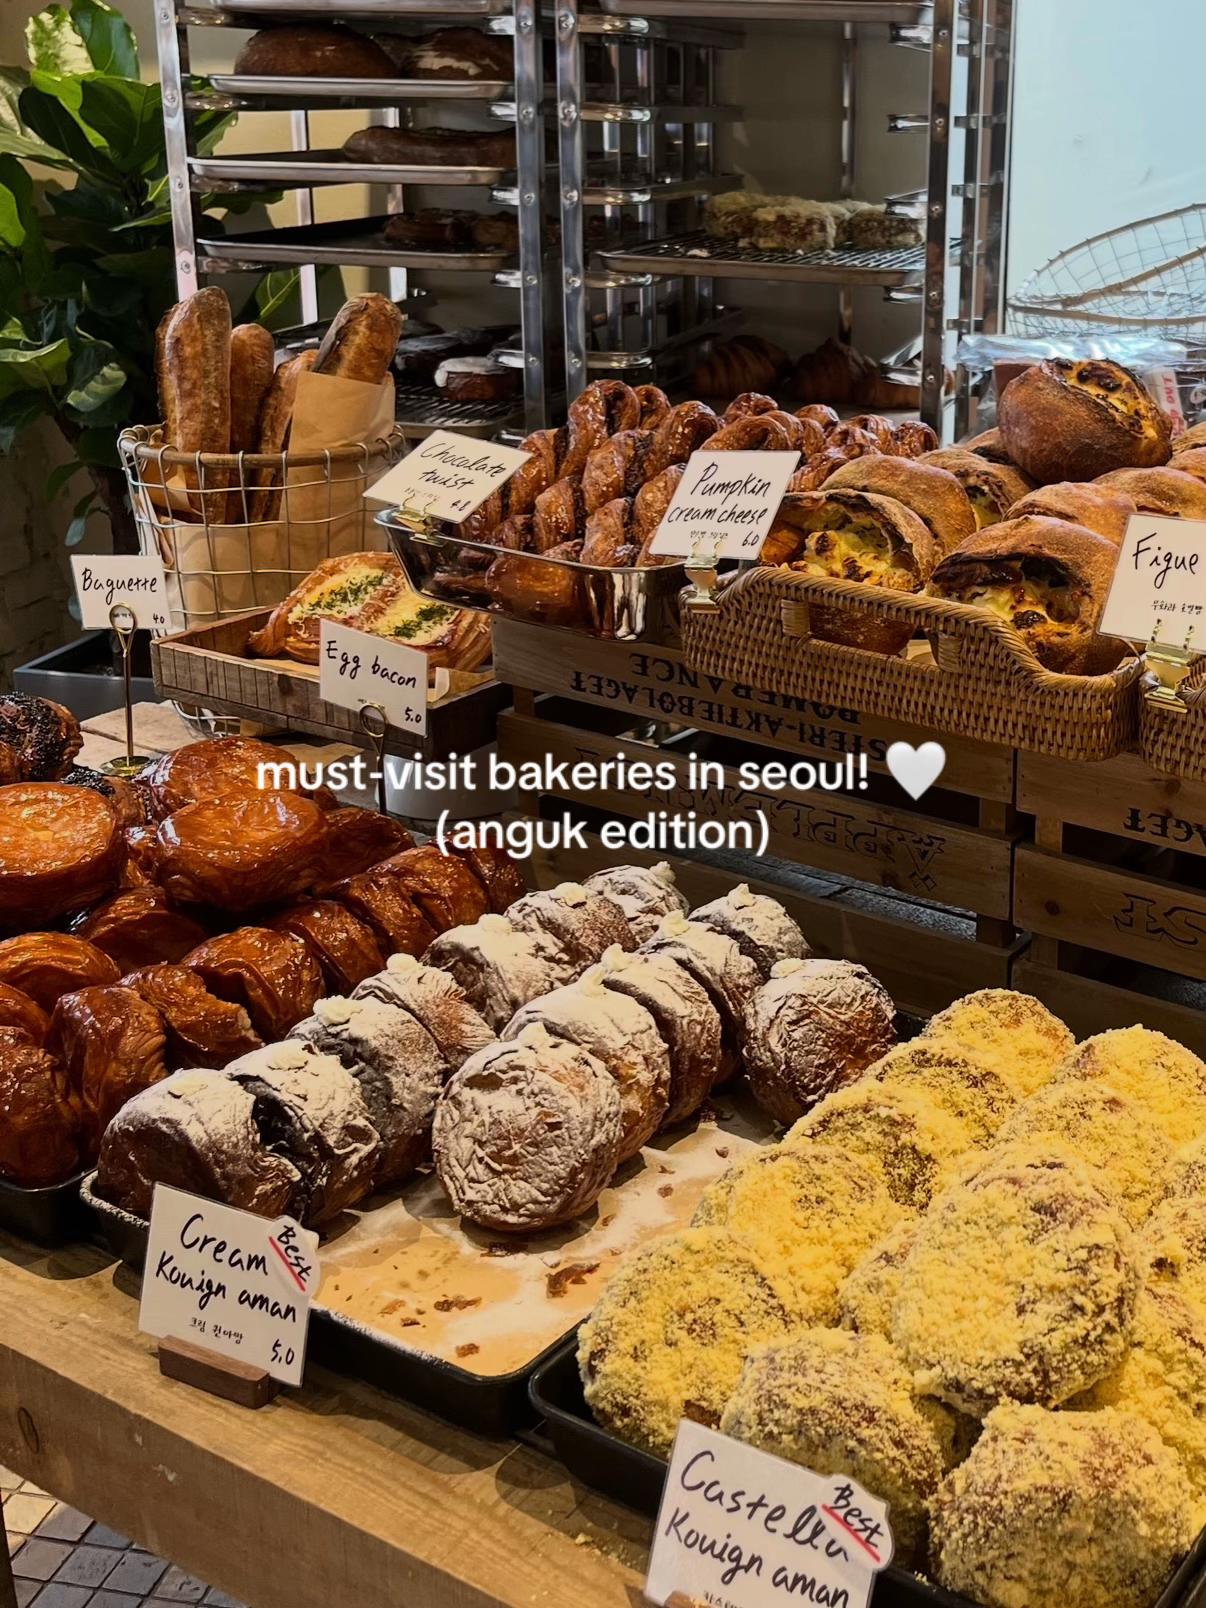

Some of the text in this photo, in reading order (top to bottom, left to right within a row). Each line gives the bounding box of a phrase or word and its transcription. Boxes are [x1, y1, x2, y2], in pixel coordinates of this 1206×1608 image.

[418, 468, 475, 490] twist
[420, 442, 507, 477] Chocolate
[690, 461, 772, 505] Pumpkin
[667, 503, 769, 525] cream cheese
[81, 567, 158, 606] Baguette
[1132, 531, 1199, 590] Figue
[326, 640, 417, 689] Egg bacon
[405, 706, 422, 724] 5.0
[180, 1213, 269, 1276] Cream
[277, 1225, 313, 1283] Best
[155, 1250, 297, 1323] Kouign aman
[680, 1450, 850, 1563] Castella
[831, 1483, 884, 1549] Best
[664, 1507, 850, 1608] Kouign aman
